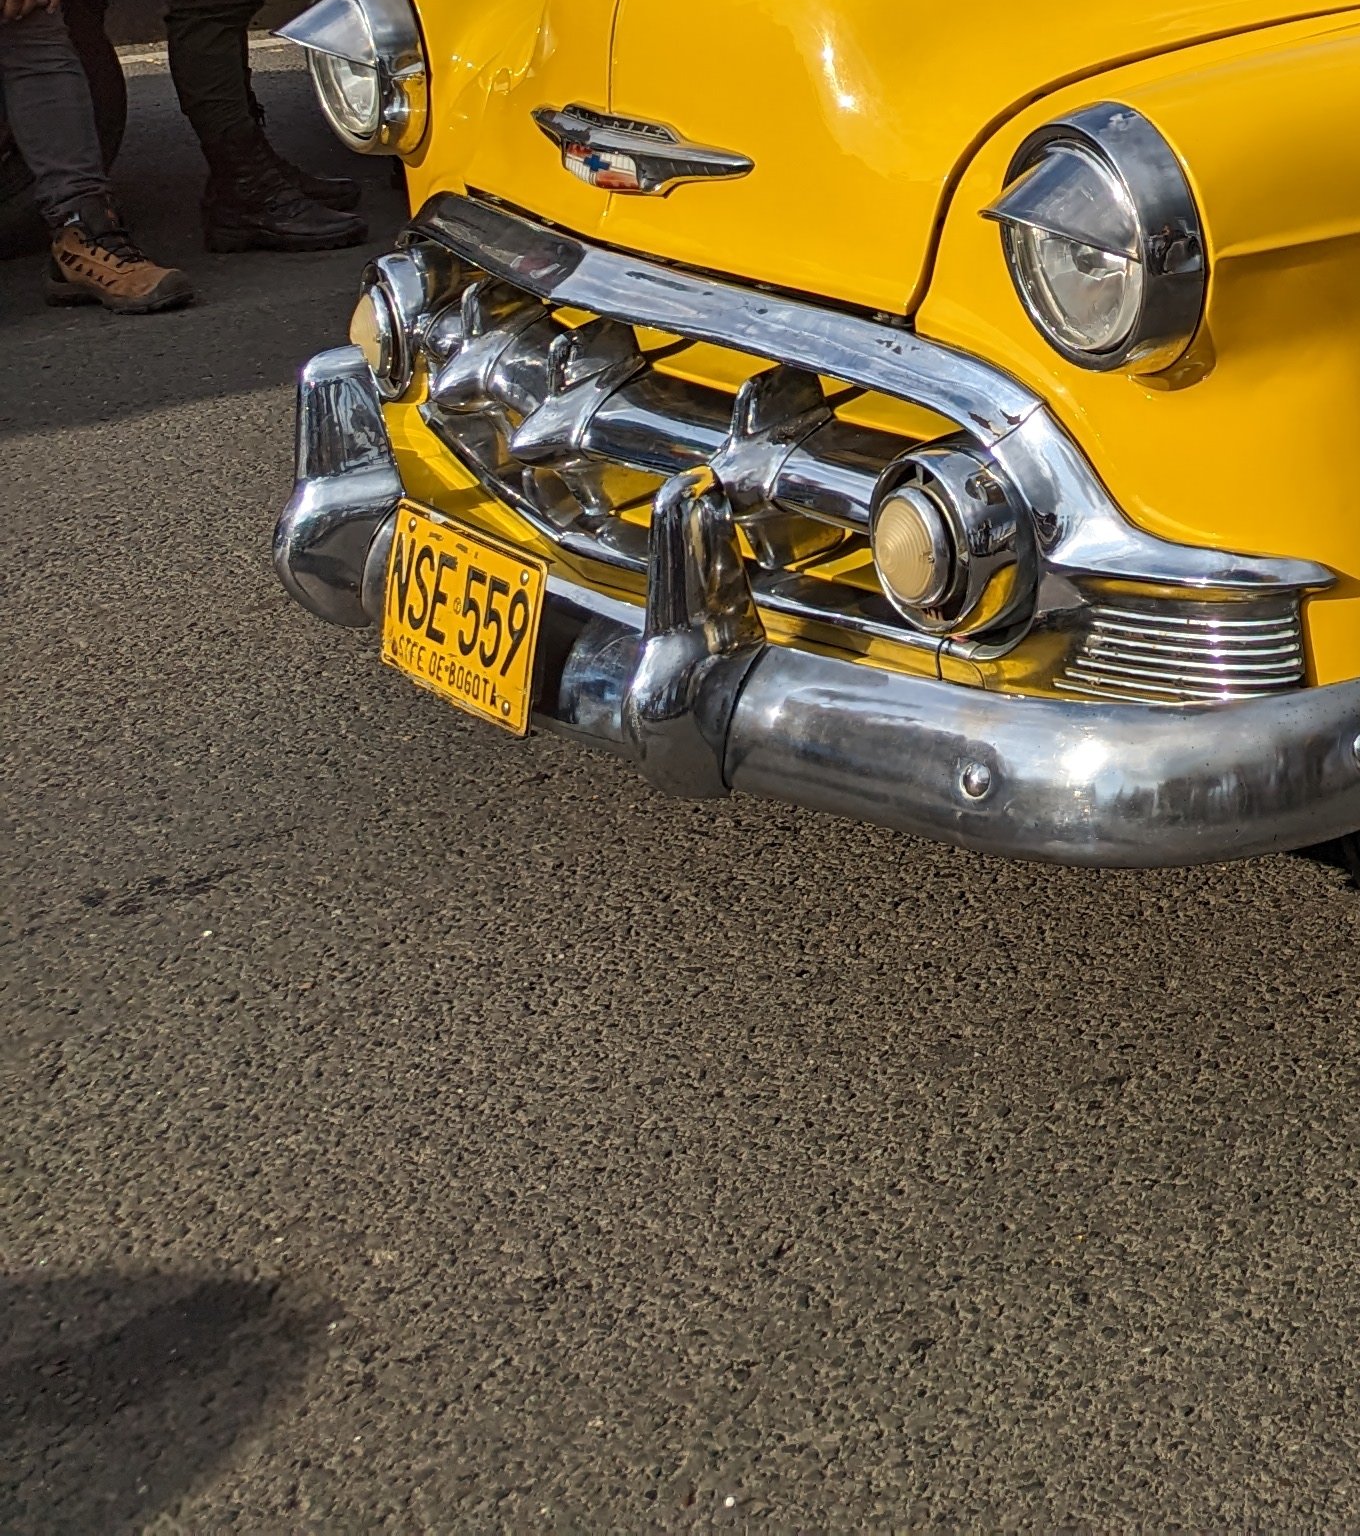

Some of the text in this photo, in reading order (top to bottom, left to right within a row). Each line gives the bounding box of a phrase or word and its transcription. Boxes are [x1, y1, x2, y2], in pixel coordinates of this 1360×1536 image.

[388, 531, 530, 677] NSE 559
[429, 651, 445, 681] DE
[449, 662, 498, 709] BOGOTA
